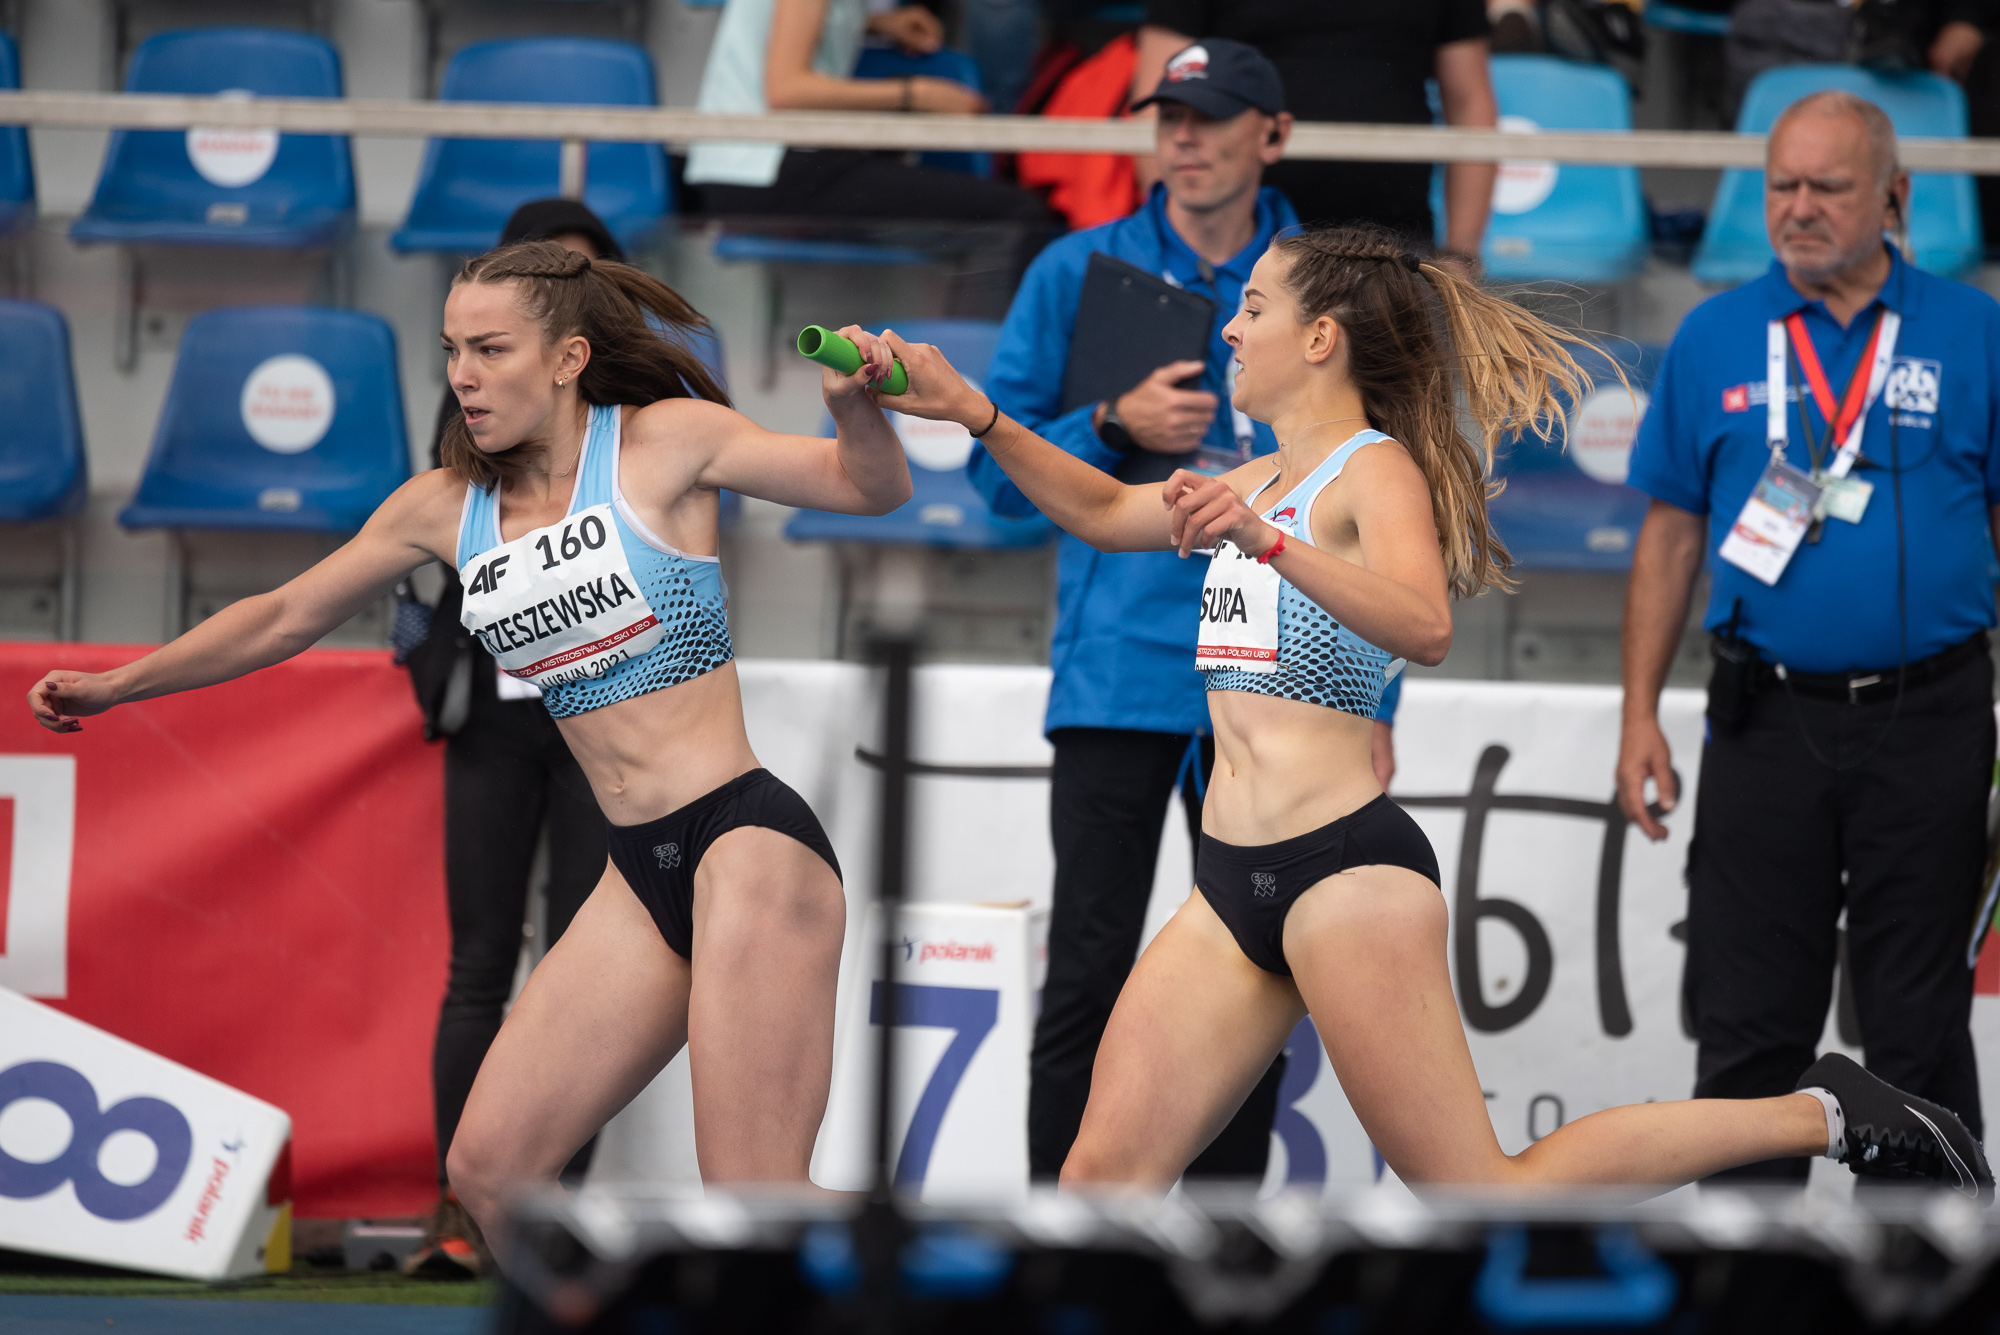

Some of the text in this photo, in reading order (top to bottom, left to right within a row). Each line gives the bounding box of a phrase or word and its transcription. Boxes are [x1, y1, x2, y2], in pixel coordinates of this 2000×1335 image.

[535, 515, 606, 571] 160
[1200, 587, 1248, 624] SURA
[541, 645, 599, 668] MISTRZOSTWA
[598, 630, 630, 650] POLSKI
[630, 620, 651, 634] U20
[590, 649, 631, 676] 2021
[1227, 649, 1253, 658] POLSKI
[1253, 650, 1270, 659] U20
[919, 939, 998, 963] polanik
[869, 980, 1000, 1196] 7
[0, 1059, 194, 1223] 8
[184, 1154, 231, 1245] polanik
